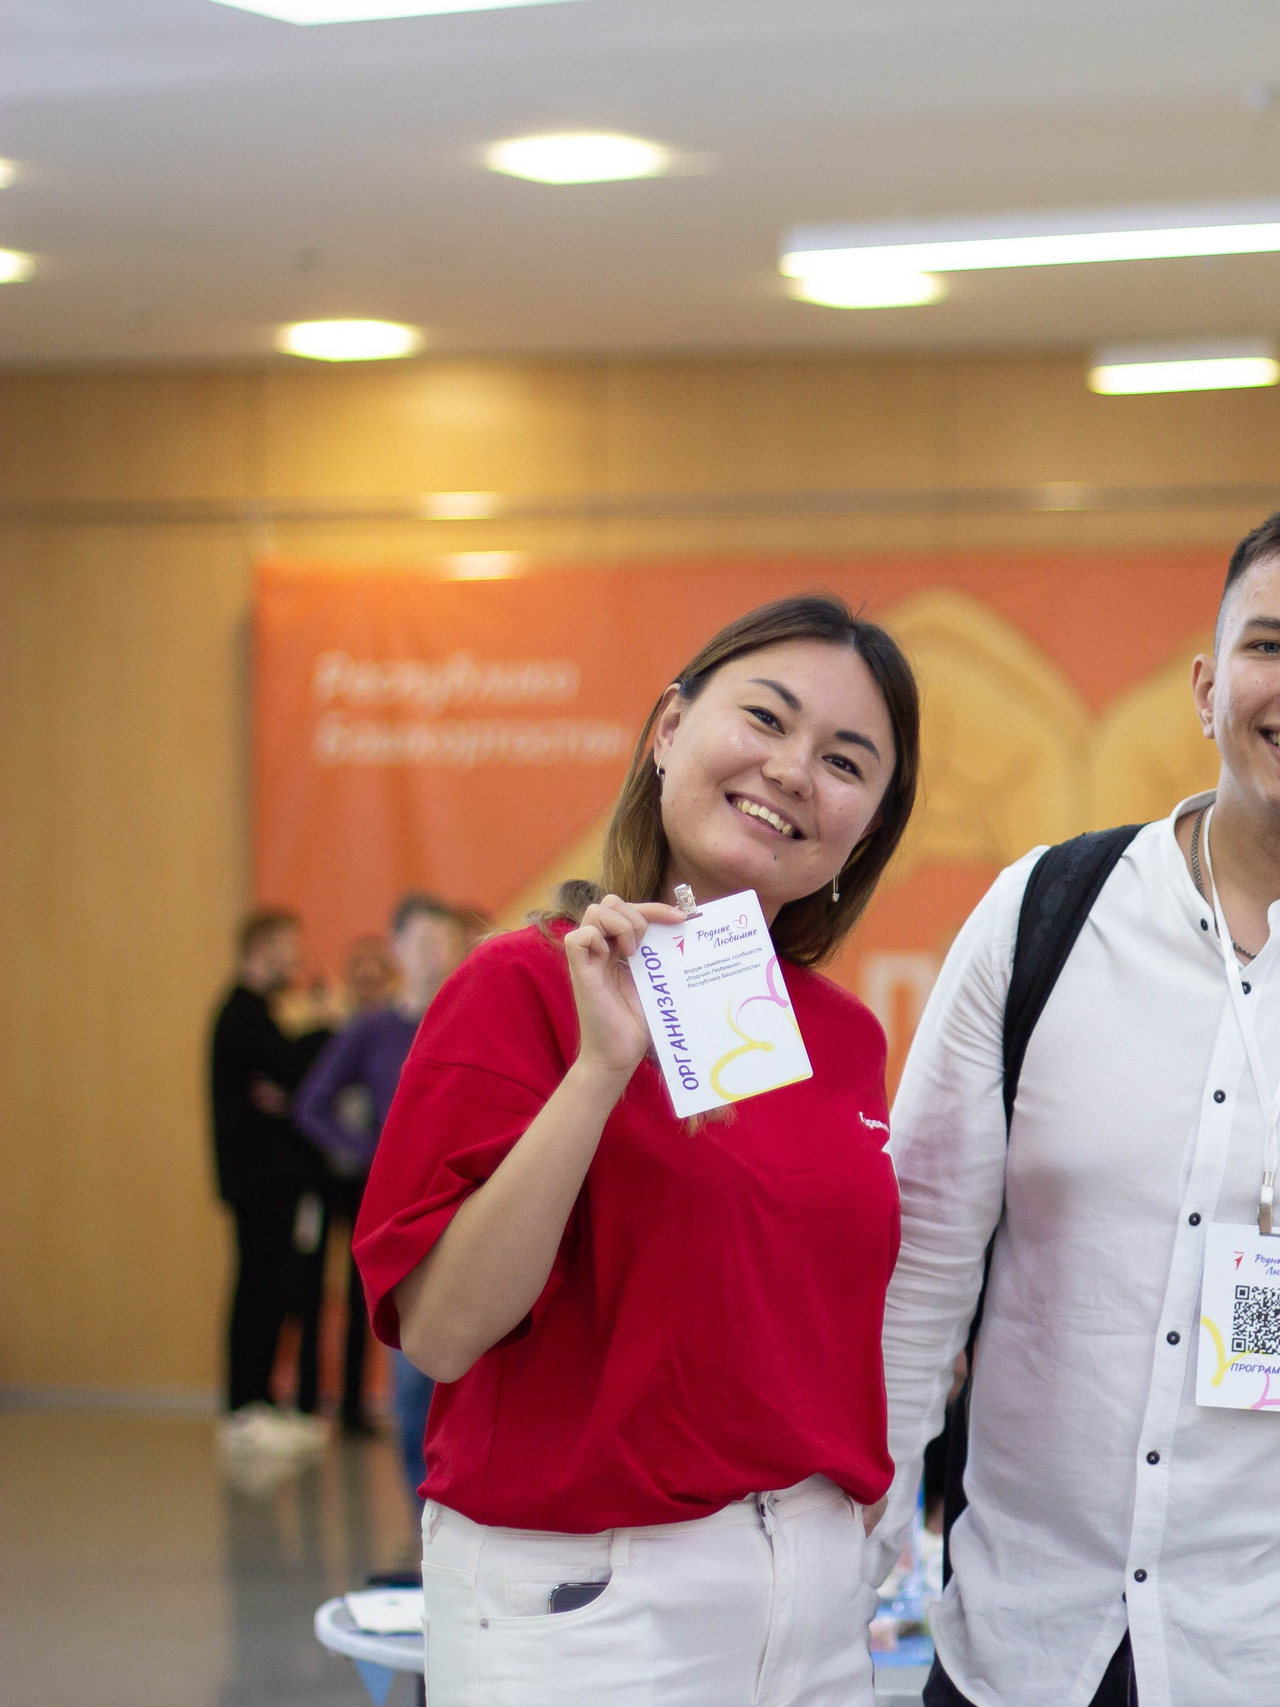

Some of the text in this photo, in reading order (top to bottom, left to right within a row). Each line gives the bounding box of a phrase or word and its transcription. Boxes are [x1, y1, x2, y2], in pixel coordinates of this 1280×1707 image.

[696, 924, 731, 941] Родные
[713, 928, 758, 949] Любимые
[683, 966, 702, 975] Форум
[687, 975, 721, 989] Республика
[640, 945, 700, 1091] ОРГАНИЗАТОР
